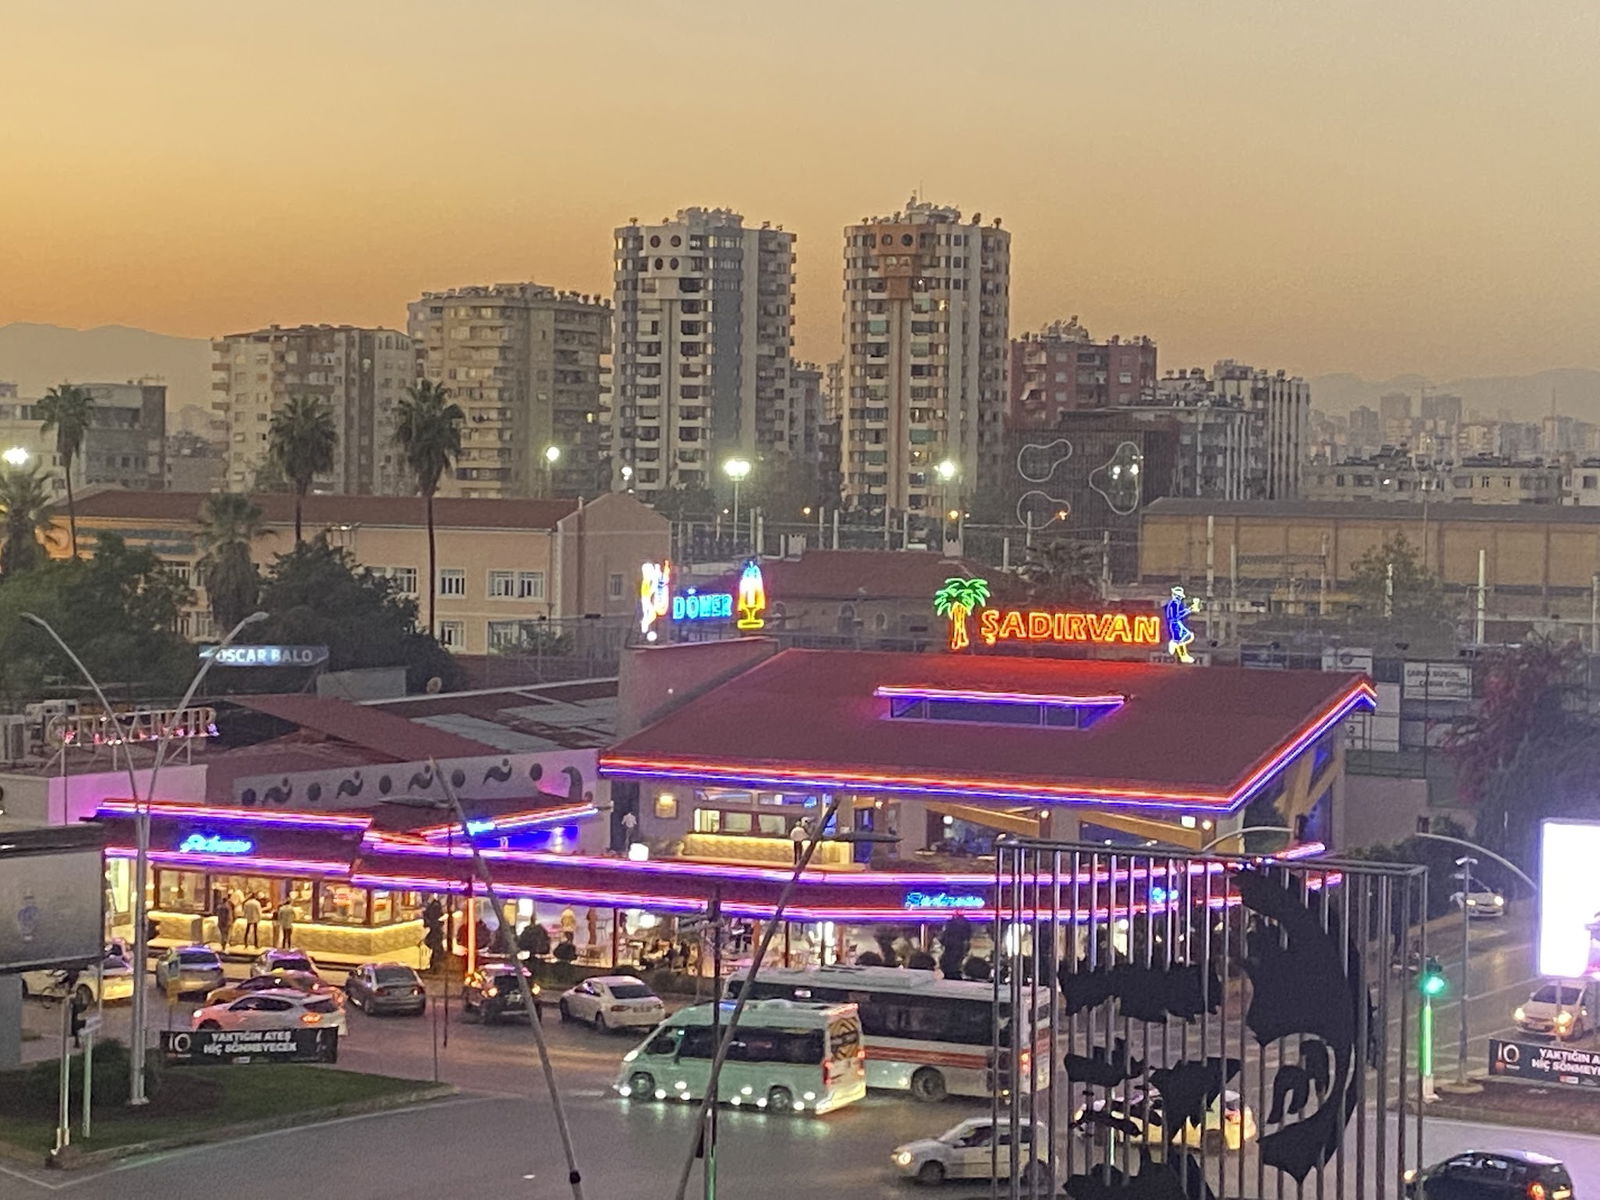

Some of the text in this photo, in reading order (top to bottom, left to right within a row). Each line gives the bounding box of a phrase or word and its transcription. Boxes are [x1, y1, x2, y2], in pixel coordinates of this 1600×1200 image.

[673, 588, 733, 619] DÖNER
[981, 610, 1161, 643] ŞADIRVAN
[216, 648, 313, 663] OSCAR BALO
